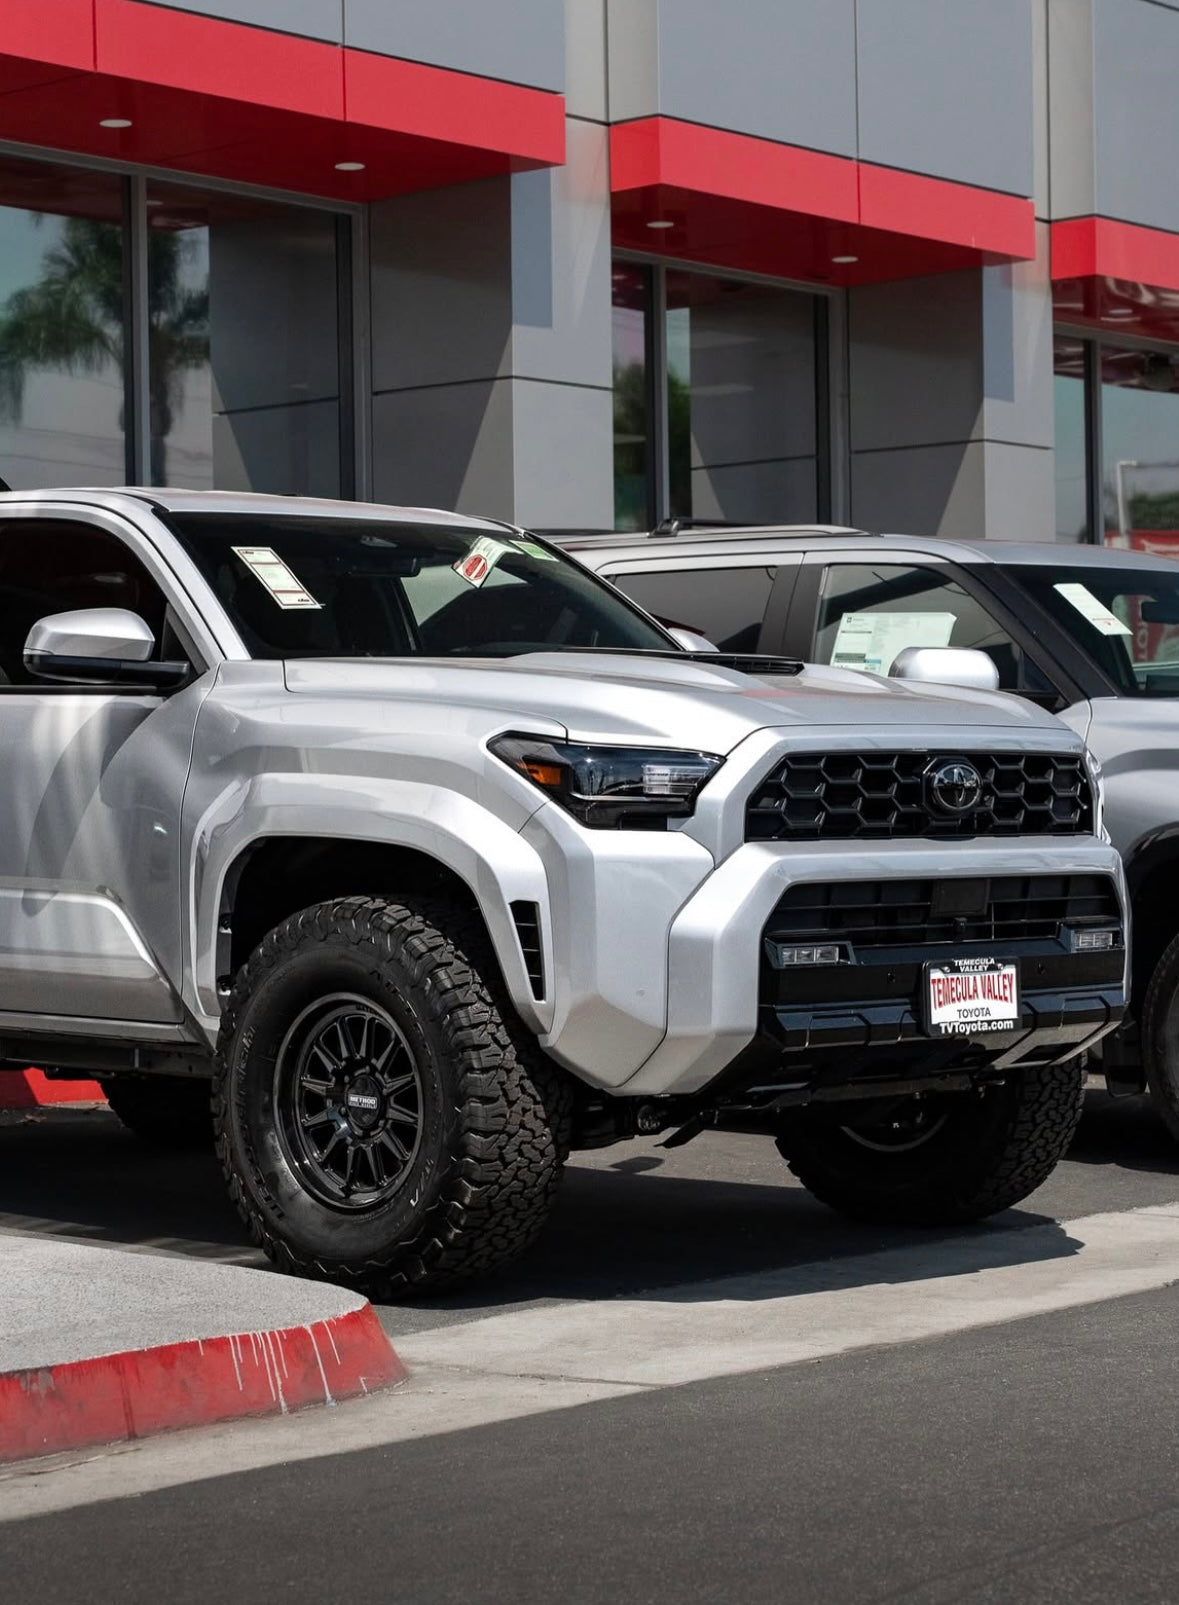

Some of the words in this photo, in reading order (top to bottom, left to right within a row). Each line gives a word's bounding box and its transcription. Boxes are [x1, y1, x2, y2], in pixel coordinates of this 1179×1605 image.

[953, 958, 995, 966] TEMECULA
[931, 976, 980, 1010] TEMECULA
[981, 973, 1013, 1003] VALLEY
[957, 1007, 991, 1018] TOYOTA
[940, 1020, 1014, 1035] TVToyota.com
